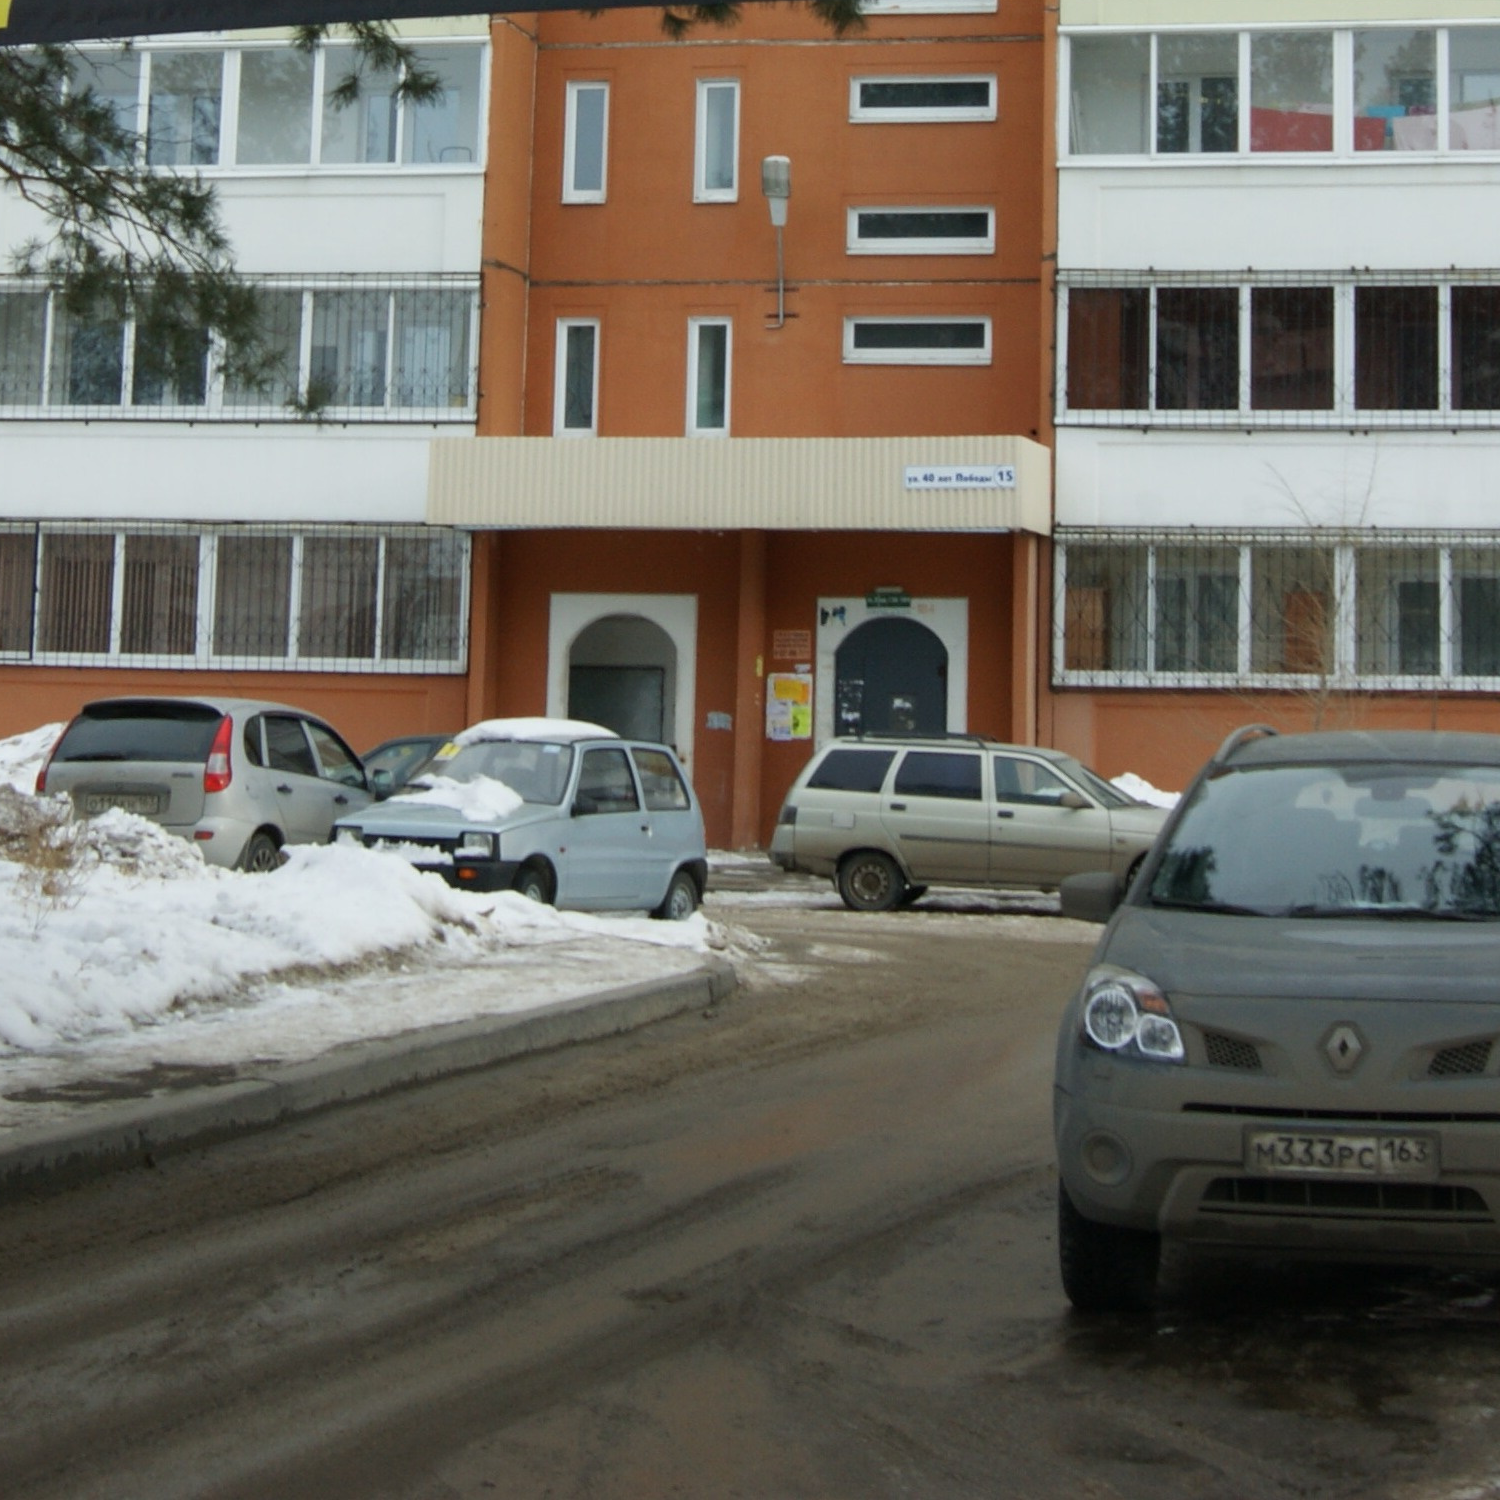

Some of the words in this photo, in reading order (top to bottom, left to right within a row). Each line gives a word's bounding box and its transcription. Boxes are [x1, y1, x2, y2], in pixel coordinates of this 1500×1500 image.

[922, 473, 935, 483] 40
[955, 472, 992, 483] Победы
[997, 470, 1013, 482] 15
[1384, 1139, 1428, 1163] 163
